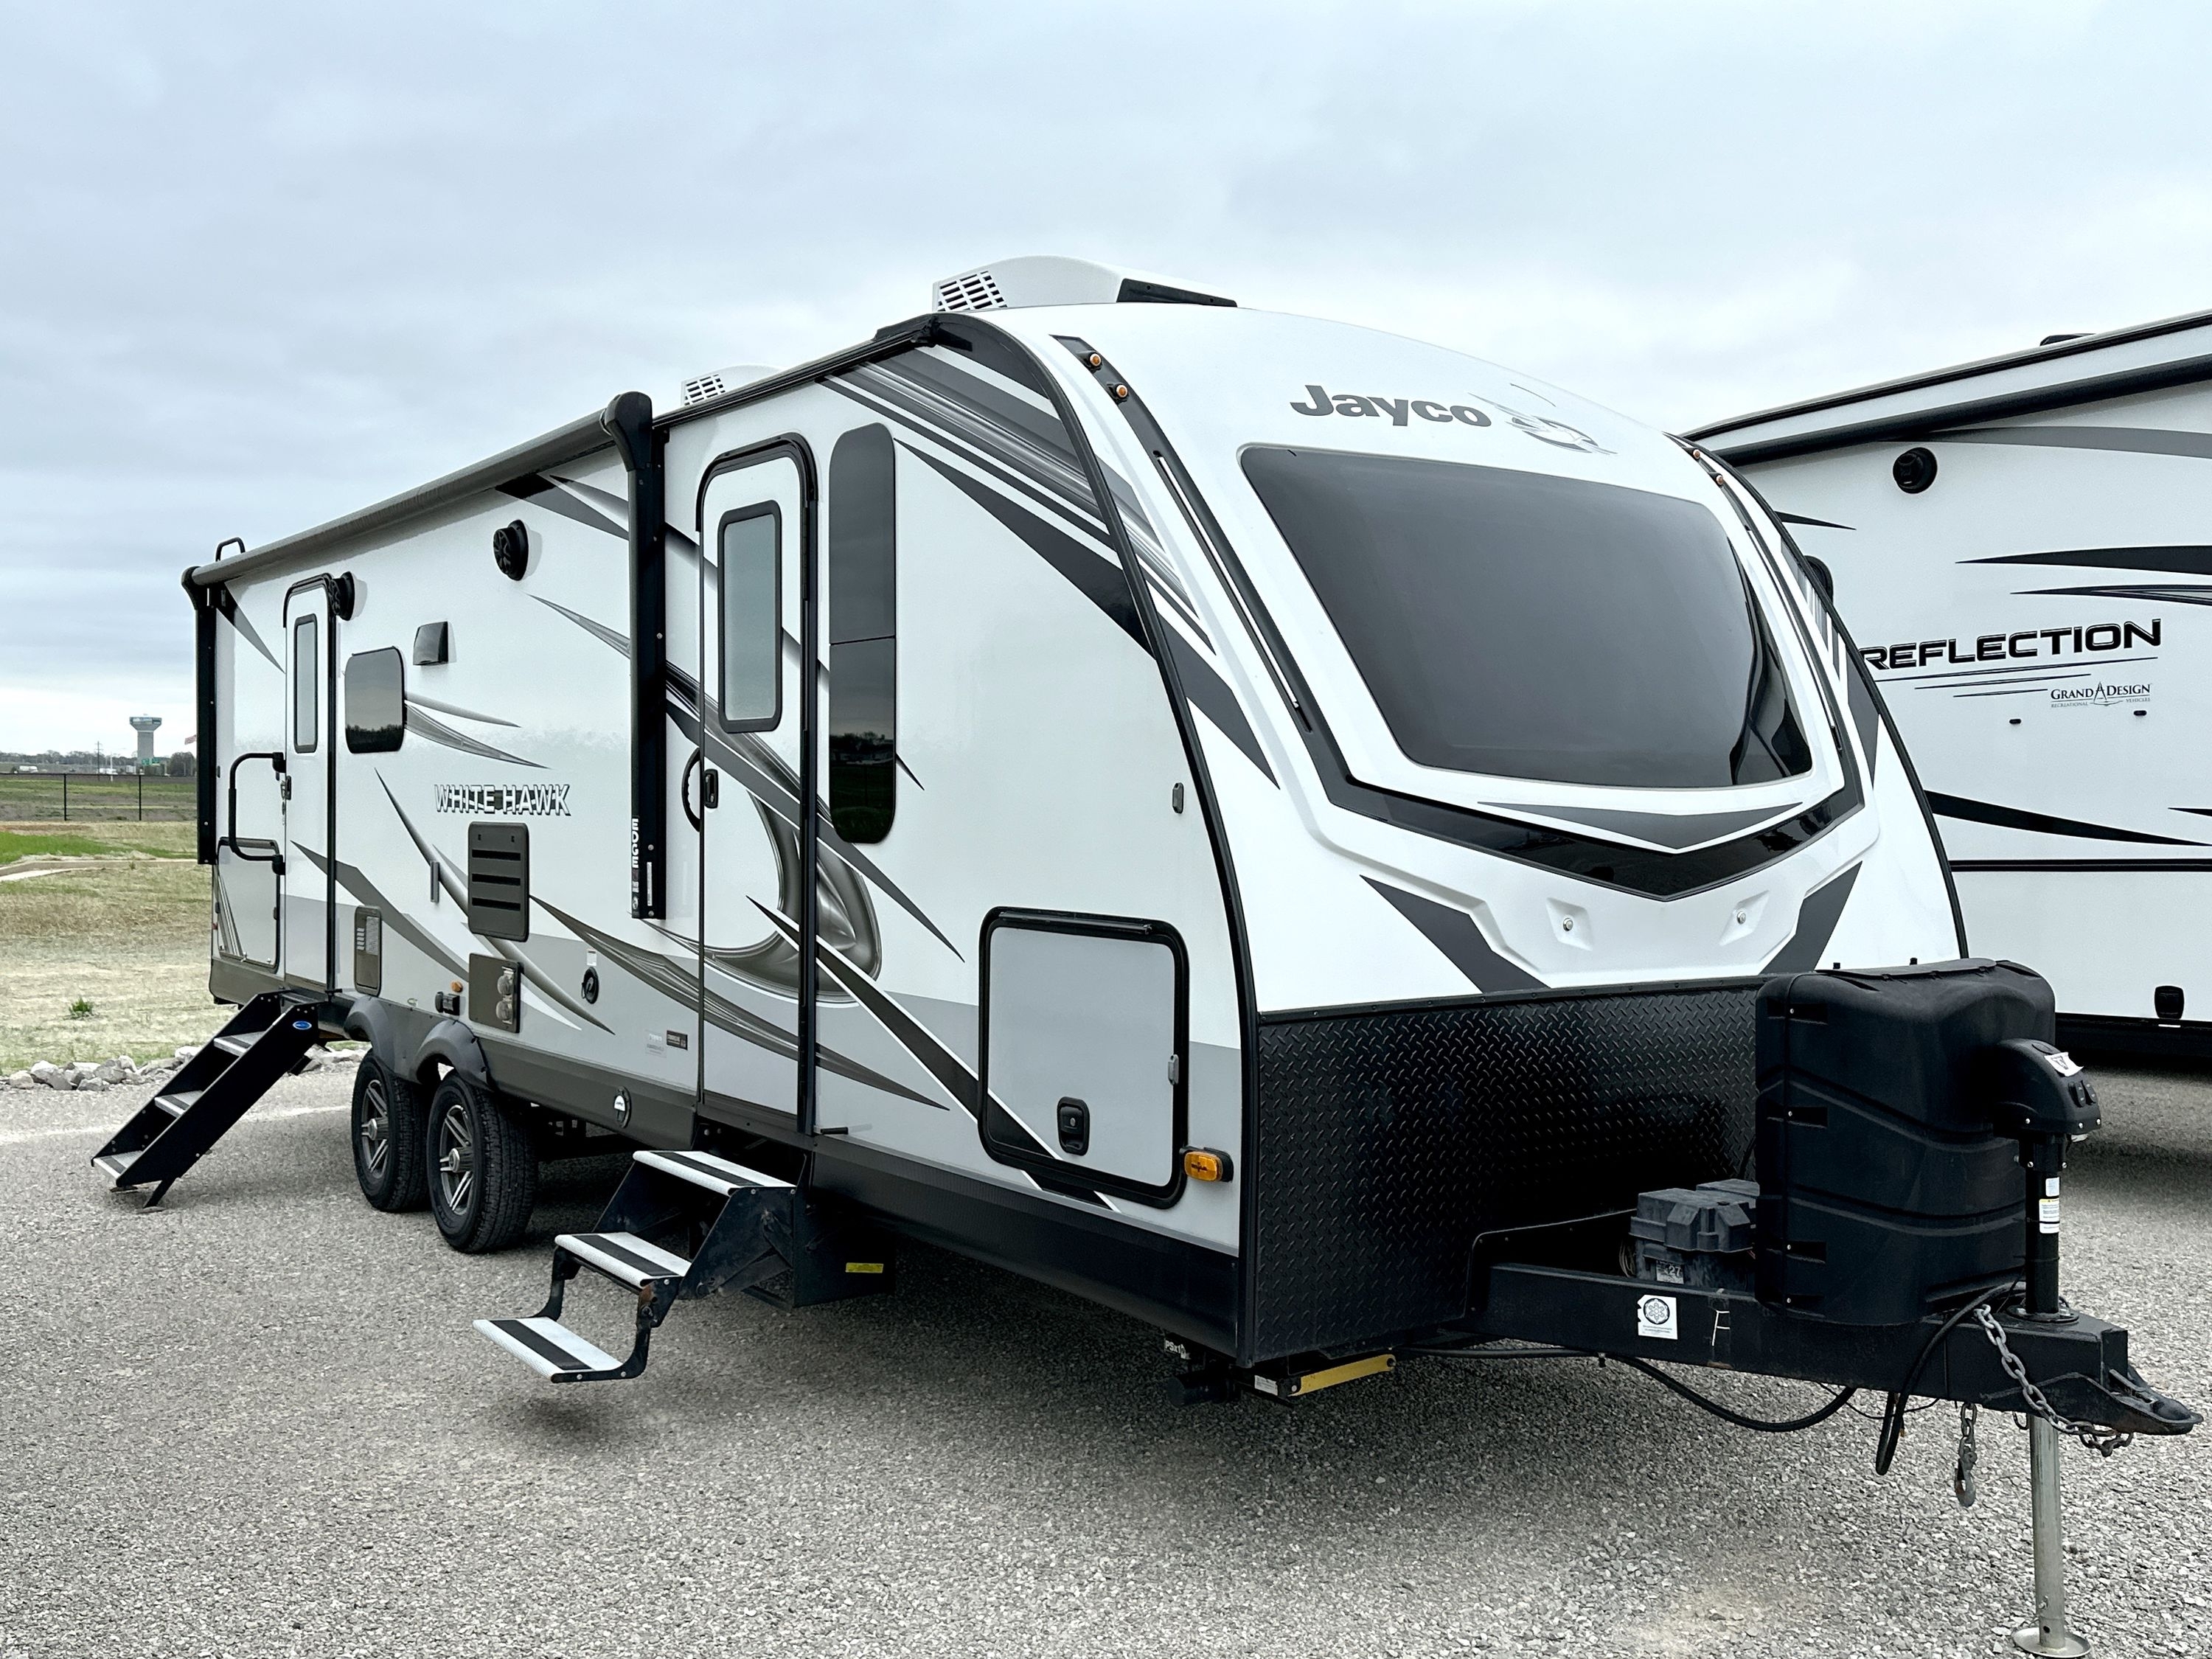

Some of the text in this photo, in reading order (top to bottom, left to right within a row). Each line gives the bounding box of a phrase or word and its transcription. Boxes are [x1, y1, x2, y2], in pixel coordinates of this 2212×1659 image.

[1290, 384, 1492, 427] Jayco
[1858, 618, 2161, 670] REFLECTION
[2051, 683, 2151, 700] GRAND DESIGN
[434, 785, 571, 816] WHITE HAWK
